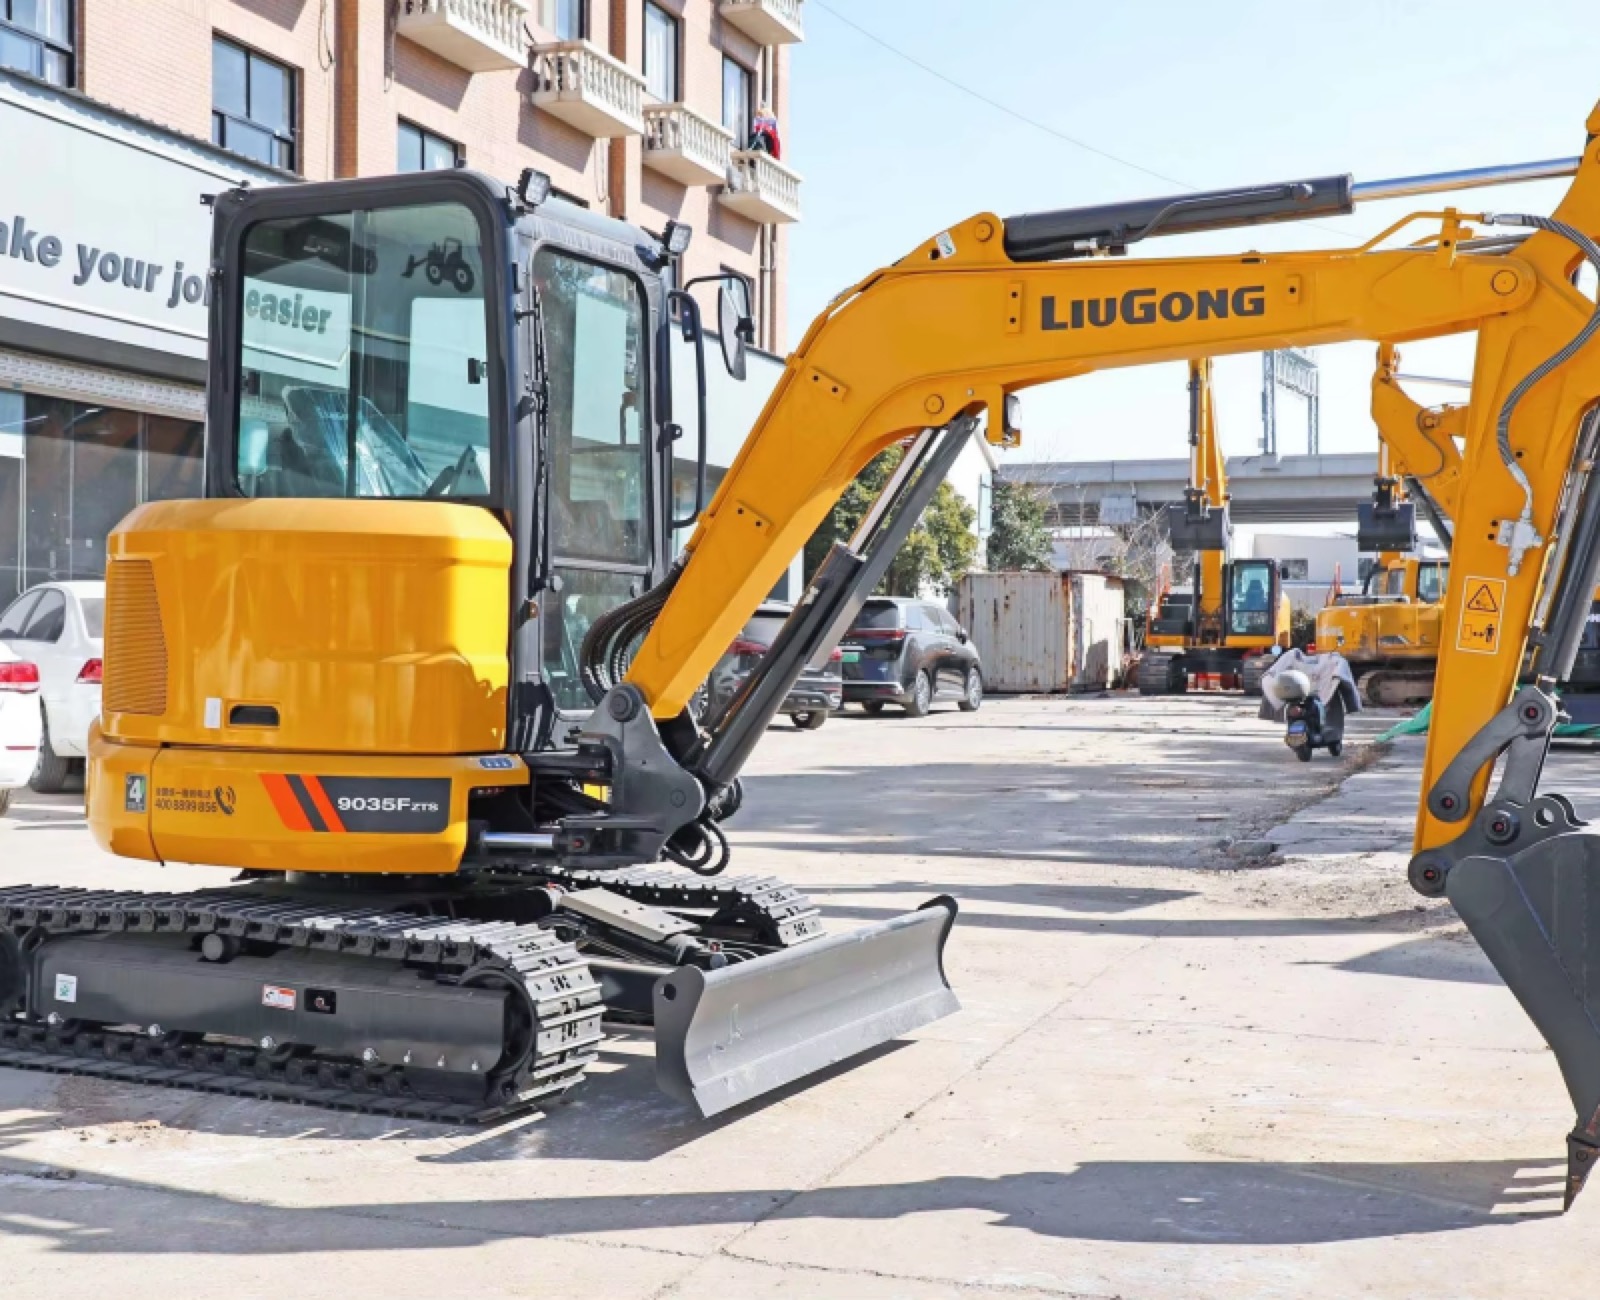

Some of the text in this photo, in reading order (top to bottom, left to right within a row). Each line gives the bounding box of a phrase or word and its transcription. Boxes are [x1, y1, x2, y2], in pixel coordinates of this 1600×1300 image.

[72, 243, 163, 293] your
[245, 289, 332, 334] easier
[129, 777, 143, 803] 4
